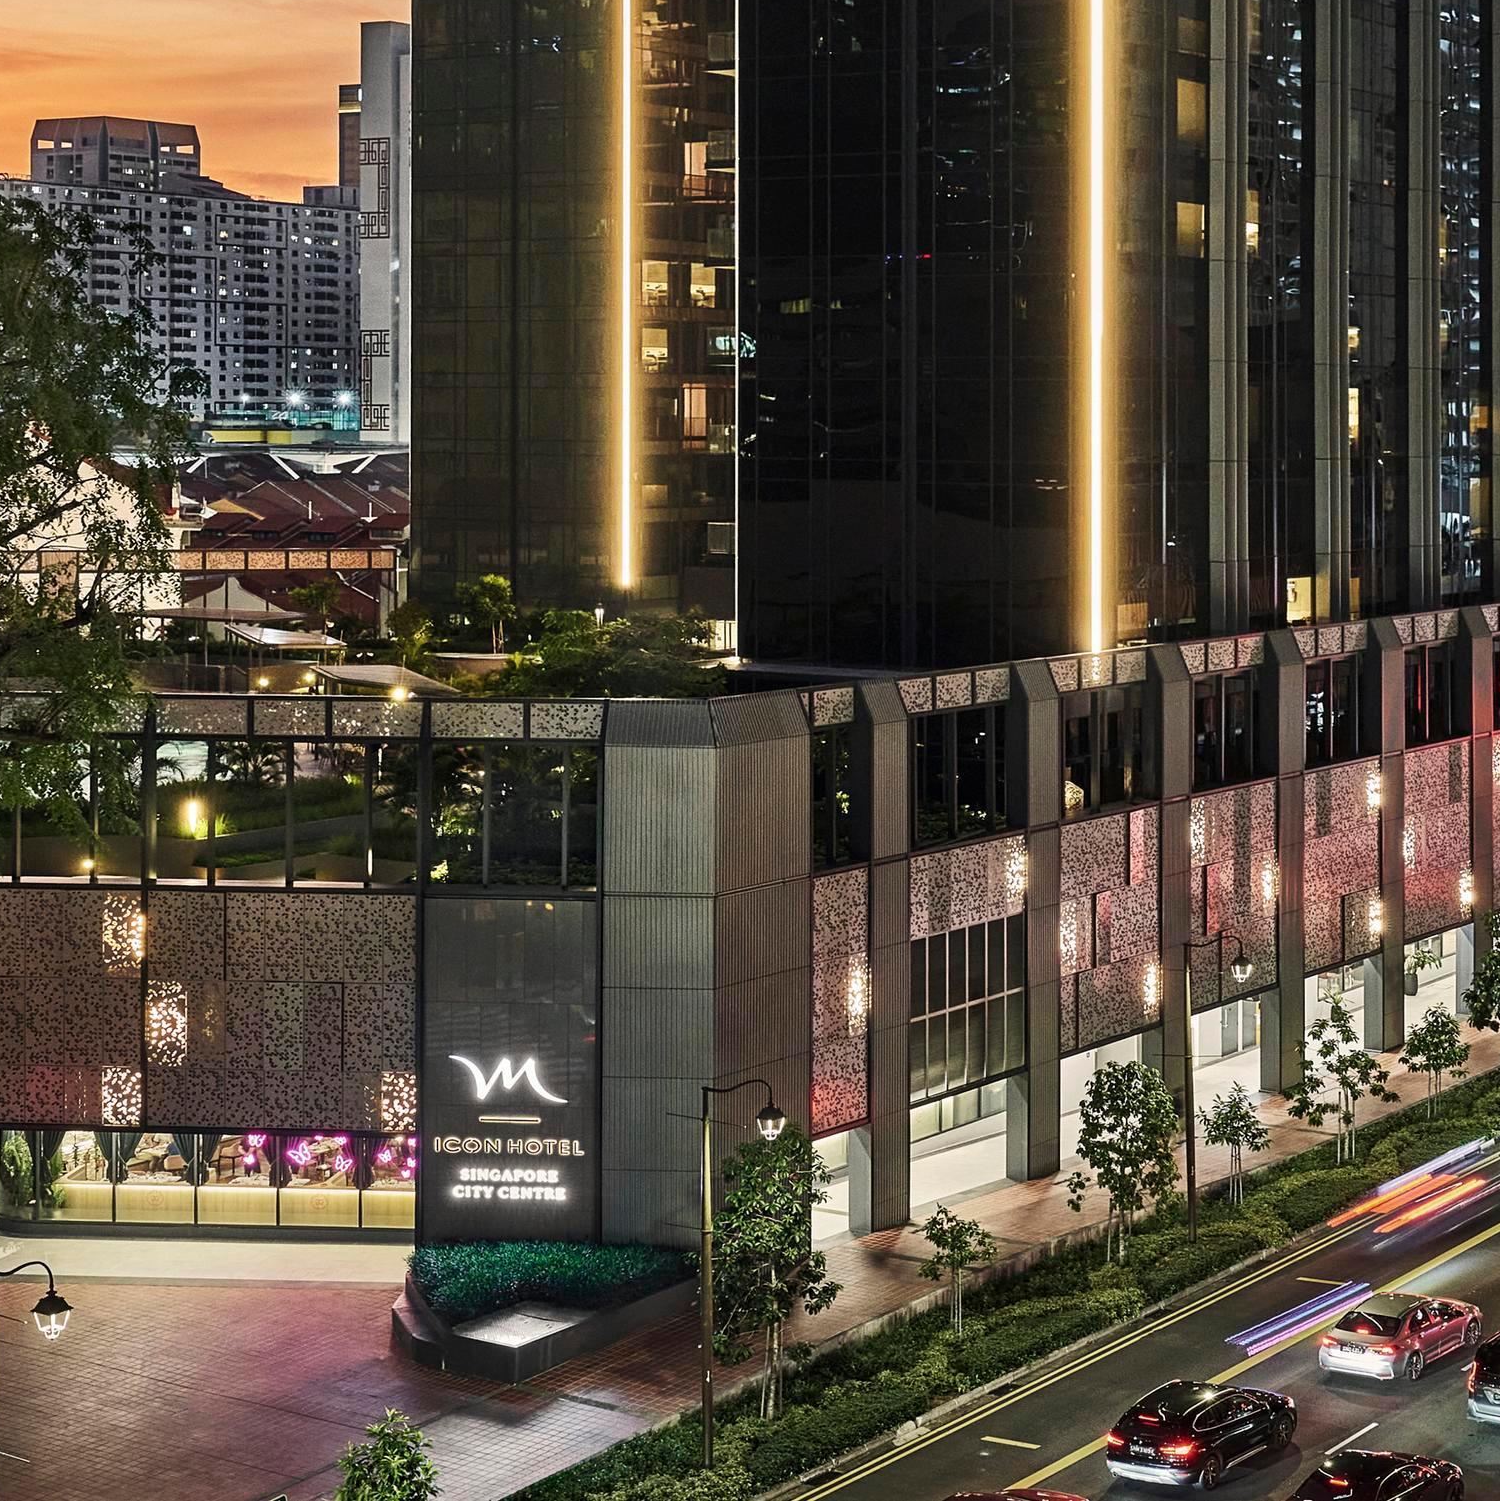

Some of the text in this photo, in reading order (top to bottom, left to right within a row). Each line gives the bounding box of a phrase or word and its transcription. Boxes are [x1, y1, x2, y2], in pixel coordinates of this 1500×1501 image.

[433, 1137, 585, 1157] ICON HOTEL
[459, 1168, 560, 1183] SINGAPORE
[452, 1185, 567, 1200] CITY CENTRE
